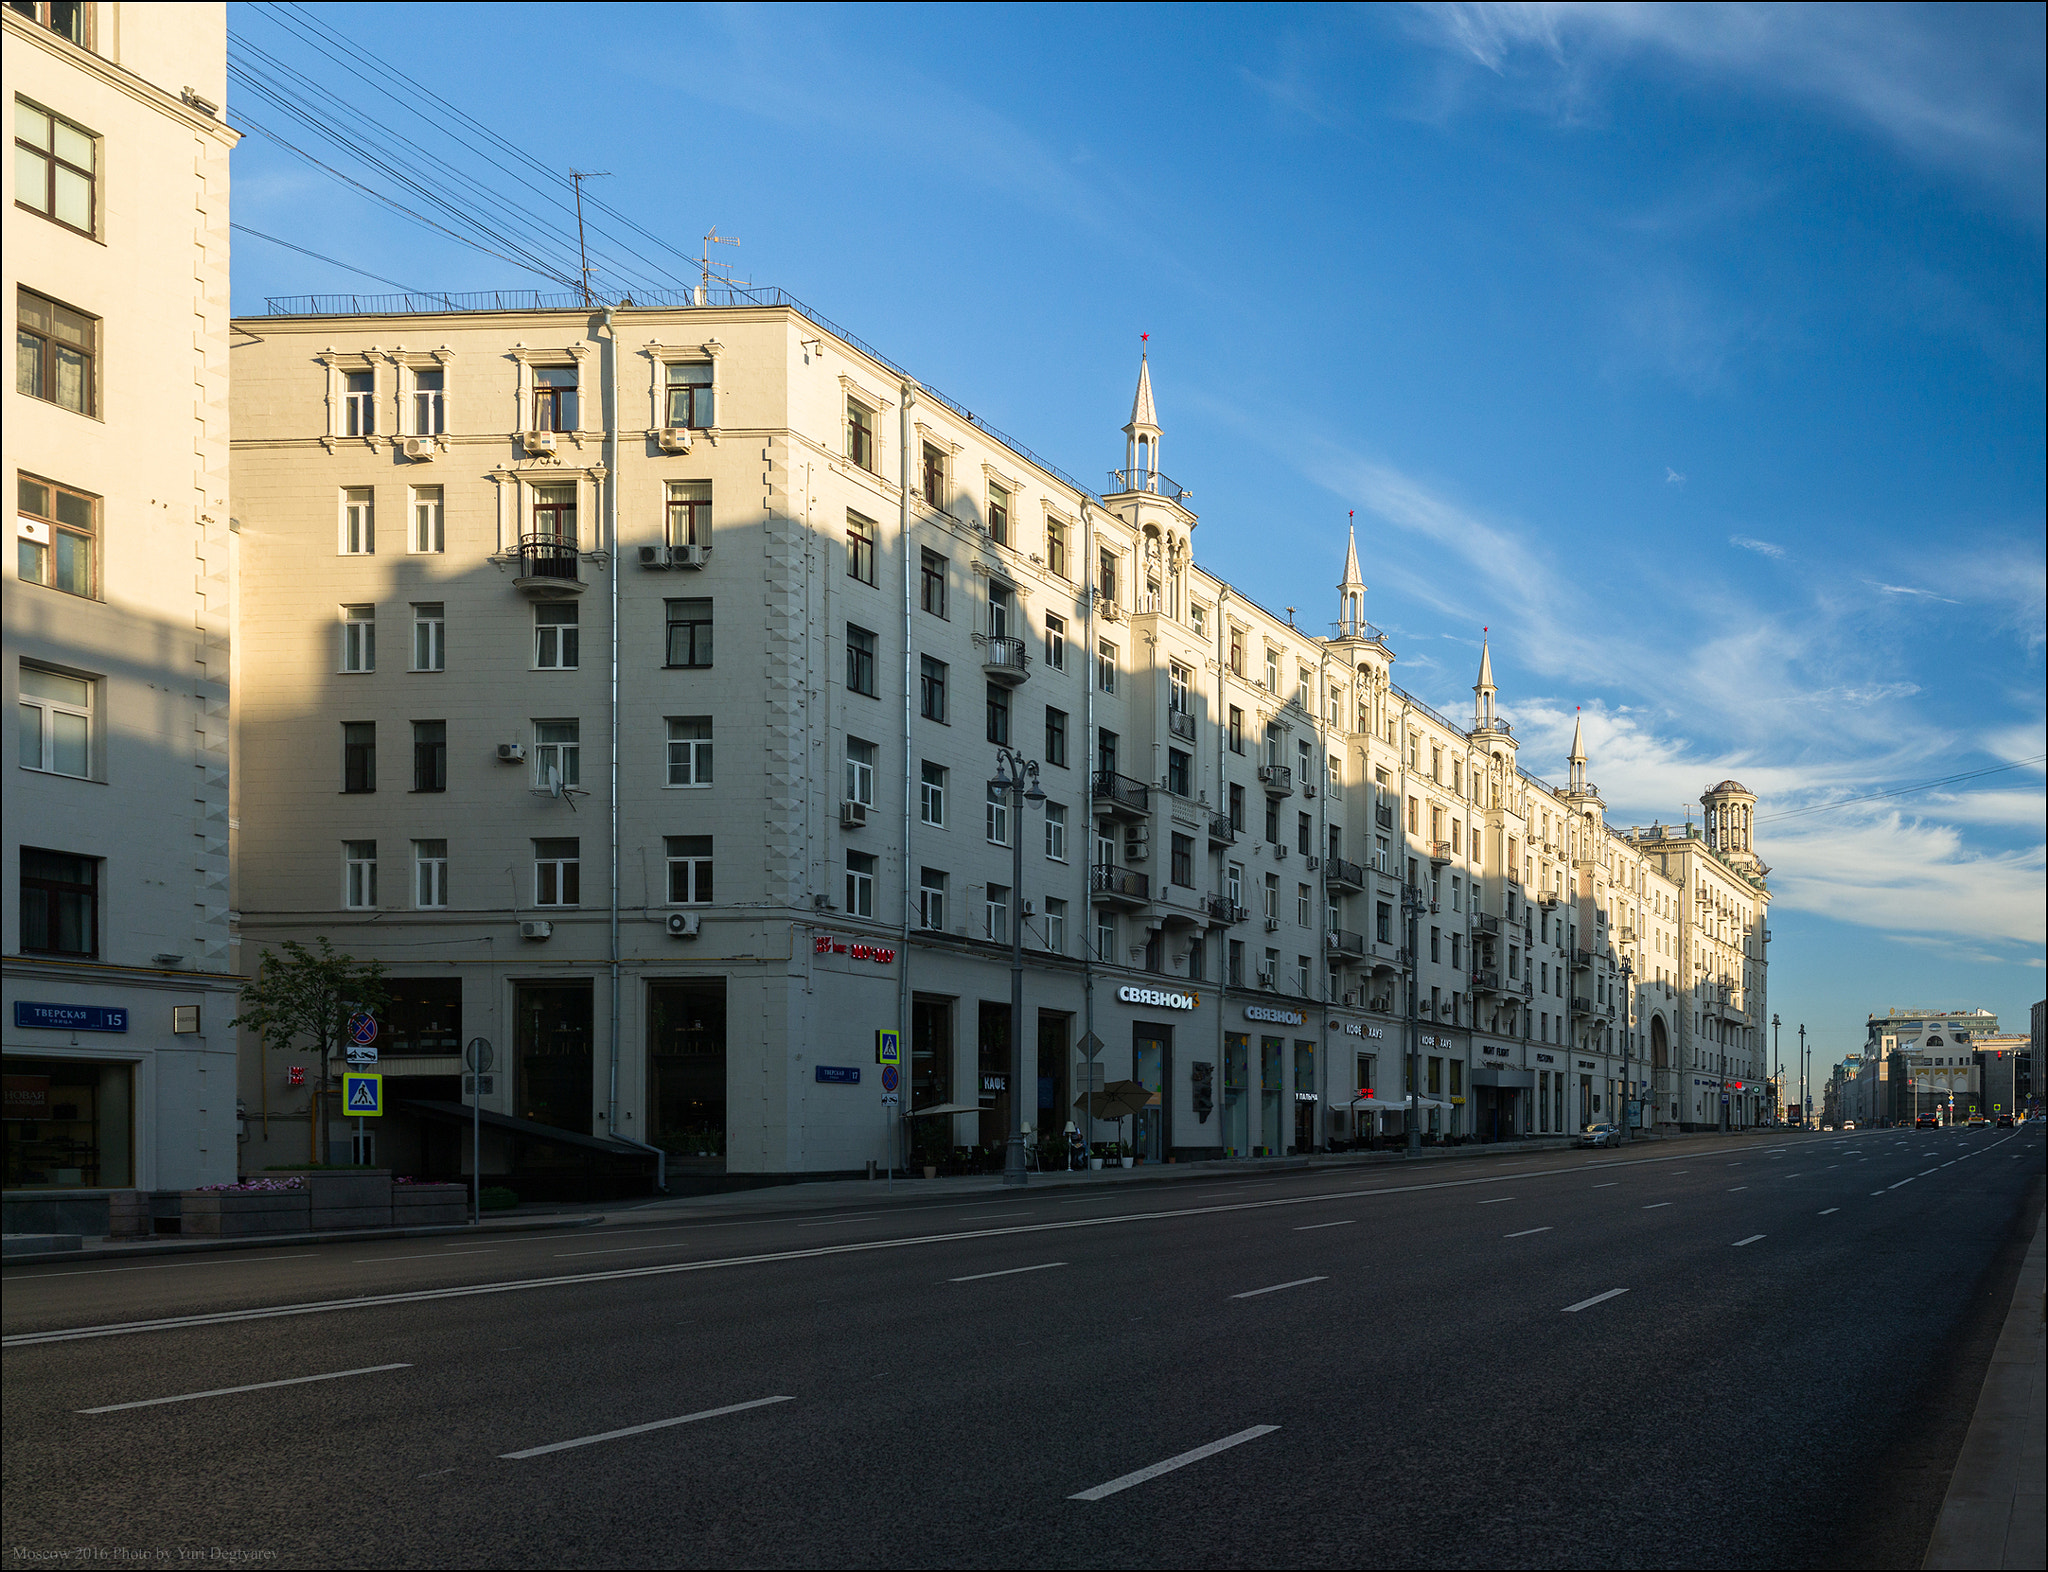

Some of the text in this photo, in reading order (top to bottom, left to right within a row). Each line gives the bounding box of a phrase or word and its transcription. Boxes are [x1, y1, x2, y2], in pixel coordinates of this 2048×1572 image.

[1119, 985, 1194, 1010] СВЯЗНОЙ
[34, 1008, 122, 1026] ТВЕРСКАЯ 15
[1246, 1004, 1302, 1025] СВЯЗНОЙ
[1345, 1024, 1383, 1039] КОФЕ ХАУЗ
[1421, 1035, 1452, 1049] КОФЕ ХАУЗ
[852, 1071, 858, 1080] 17
[984, 1076, 1006, 1091] КАФЕ
[4, 1090, 46, 1100] НОВАЯ
